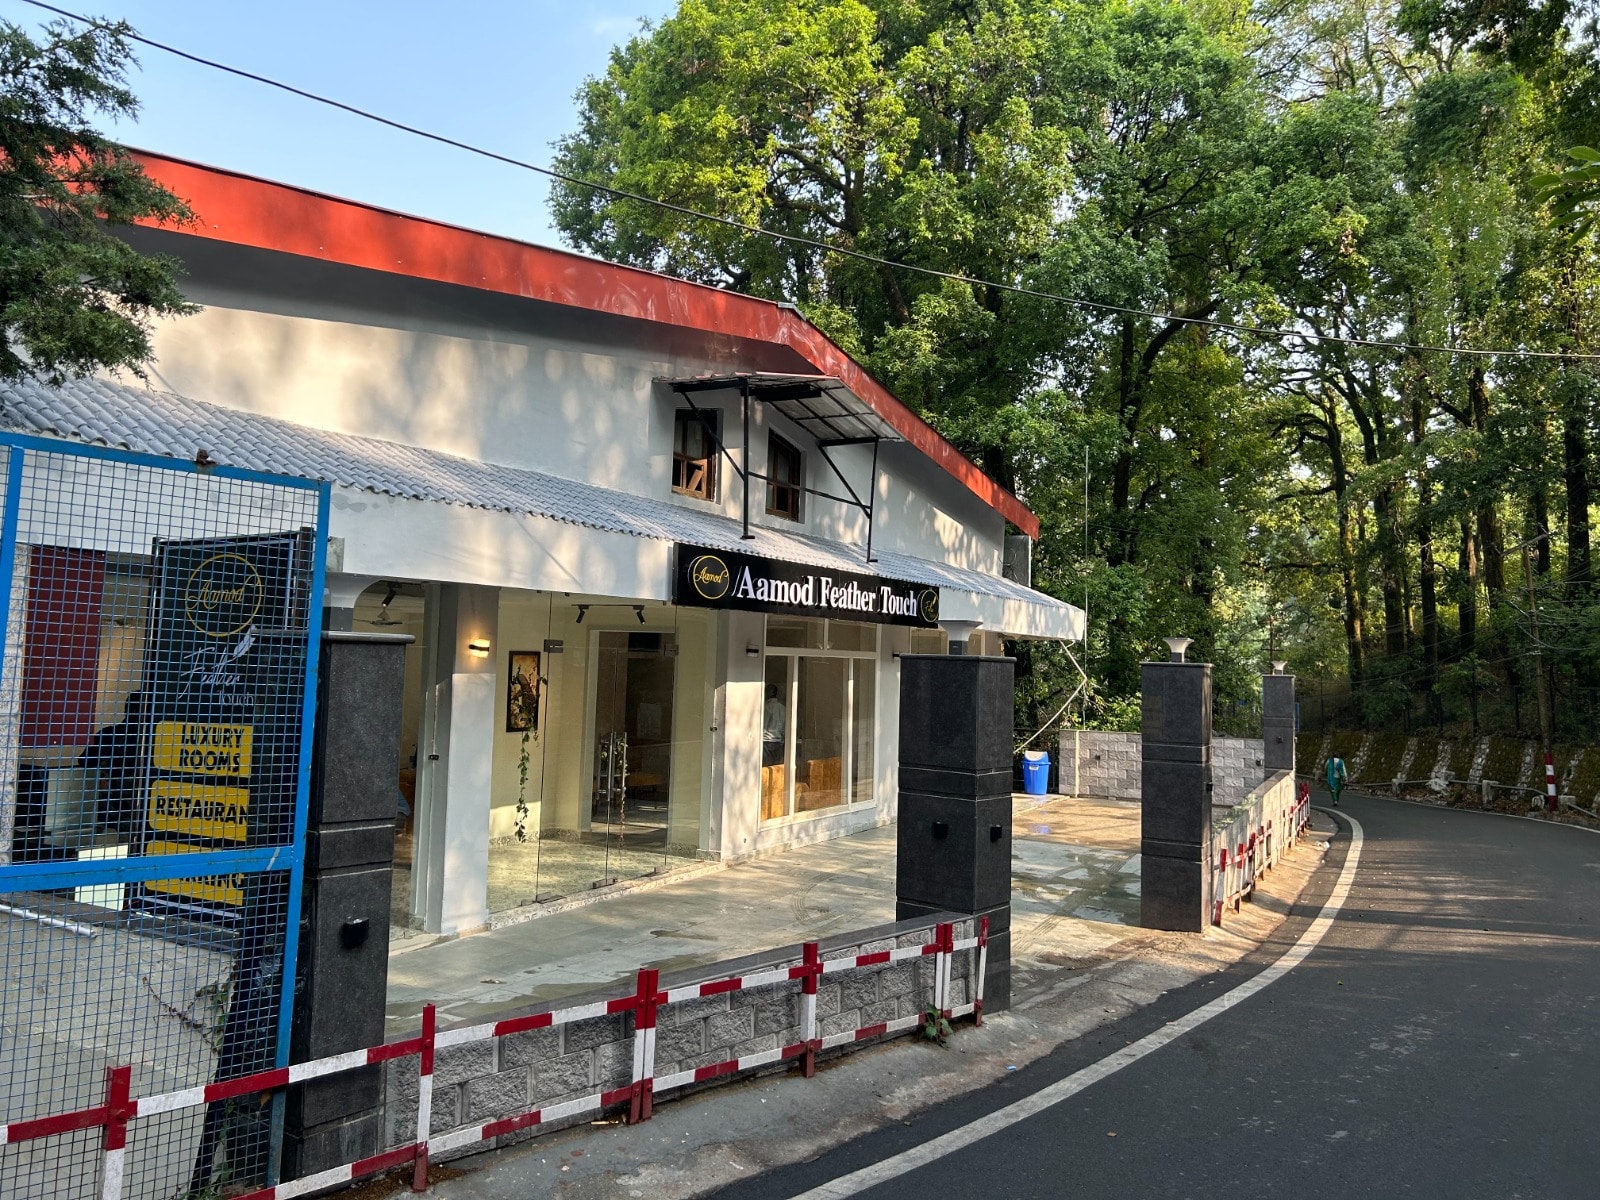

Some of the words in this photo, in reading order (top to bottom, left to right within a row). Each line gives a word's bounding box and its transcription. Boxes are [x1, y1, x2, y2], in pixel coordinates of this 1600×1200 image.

[737, 565, 814, 606] Aamod
[820, 576, 876, 612] Feather
[880, 585, 917, 617] Touch
[181, 725, 245, 748] LUXURY
[179, 748, 241, 773] ROOMS
